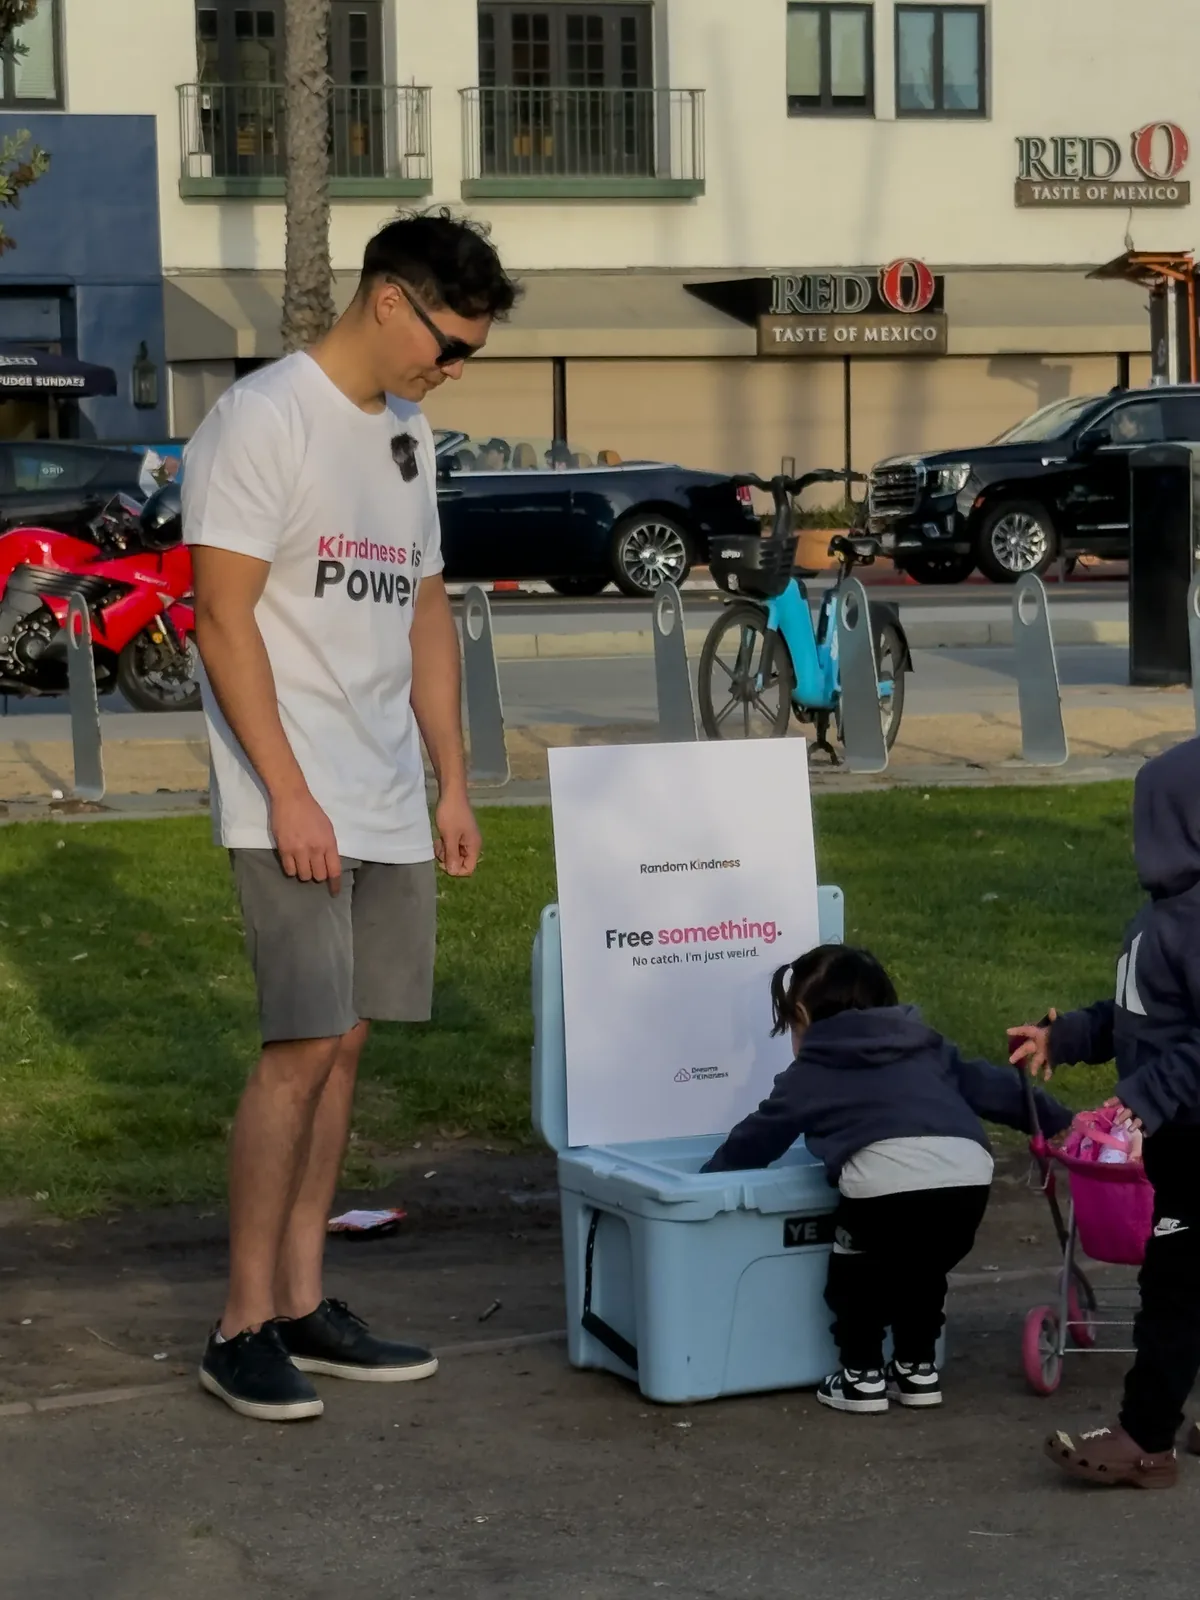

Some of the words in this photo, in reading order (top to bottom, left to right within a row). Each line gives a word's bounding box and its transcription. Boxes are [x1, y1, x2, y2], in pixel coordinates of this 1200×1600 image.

[1015, 136, 1121, 181] RED
[1130, 122, 1189, 181] O
[1031, 185, 1081, 201] TASTE
[1086, 186, 1108, 201] OF
[1113, 186, 1179, 201] MEXICO
[769, 273, 872, 314] RED
[877, 257, 936, 314] O
[772, 327, 828, 343] TASTE
[833, 327, 858, 343] OF
[864, 327, 938, 342] MEXICO
[36, 376, 85, 388] SUNDAES
[317, 533, 407, 565] Kindness
[411, 542, 422, 568] is
[640, 860, 689, 875] Random
[690, 857, 741, 871] Kindness
[605, 928, 654, 950] Free
[658, 917, 783, 945] something.
[632, 955, 648, 967] No
[650, 951, 683, 966] catch.
[686, 951, 702, 964] I'm
[704, 949, 725, 964] just
[726, 946, 760, 960] weird.
[788, 1221, 818, 1242] YE
